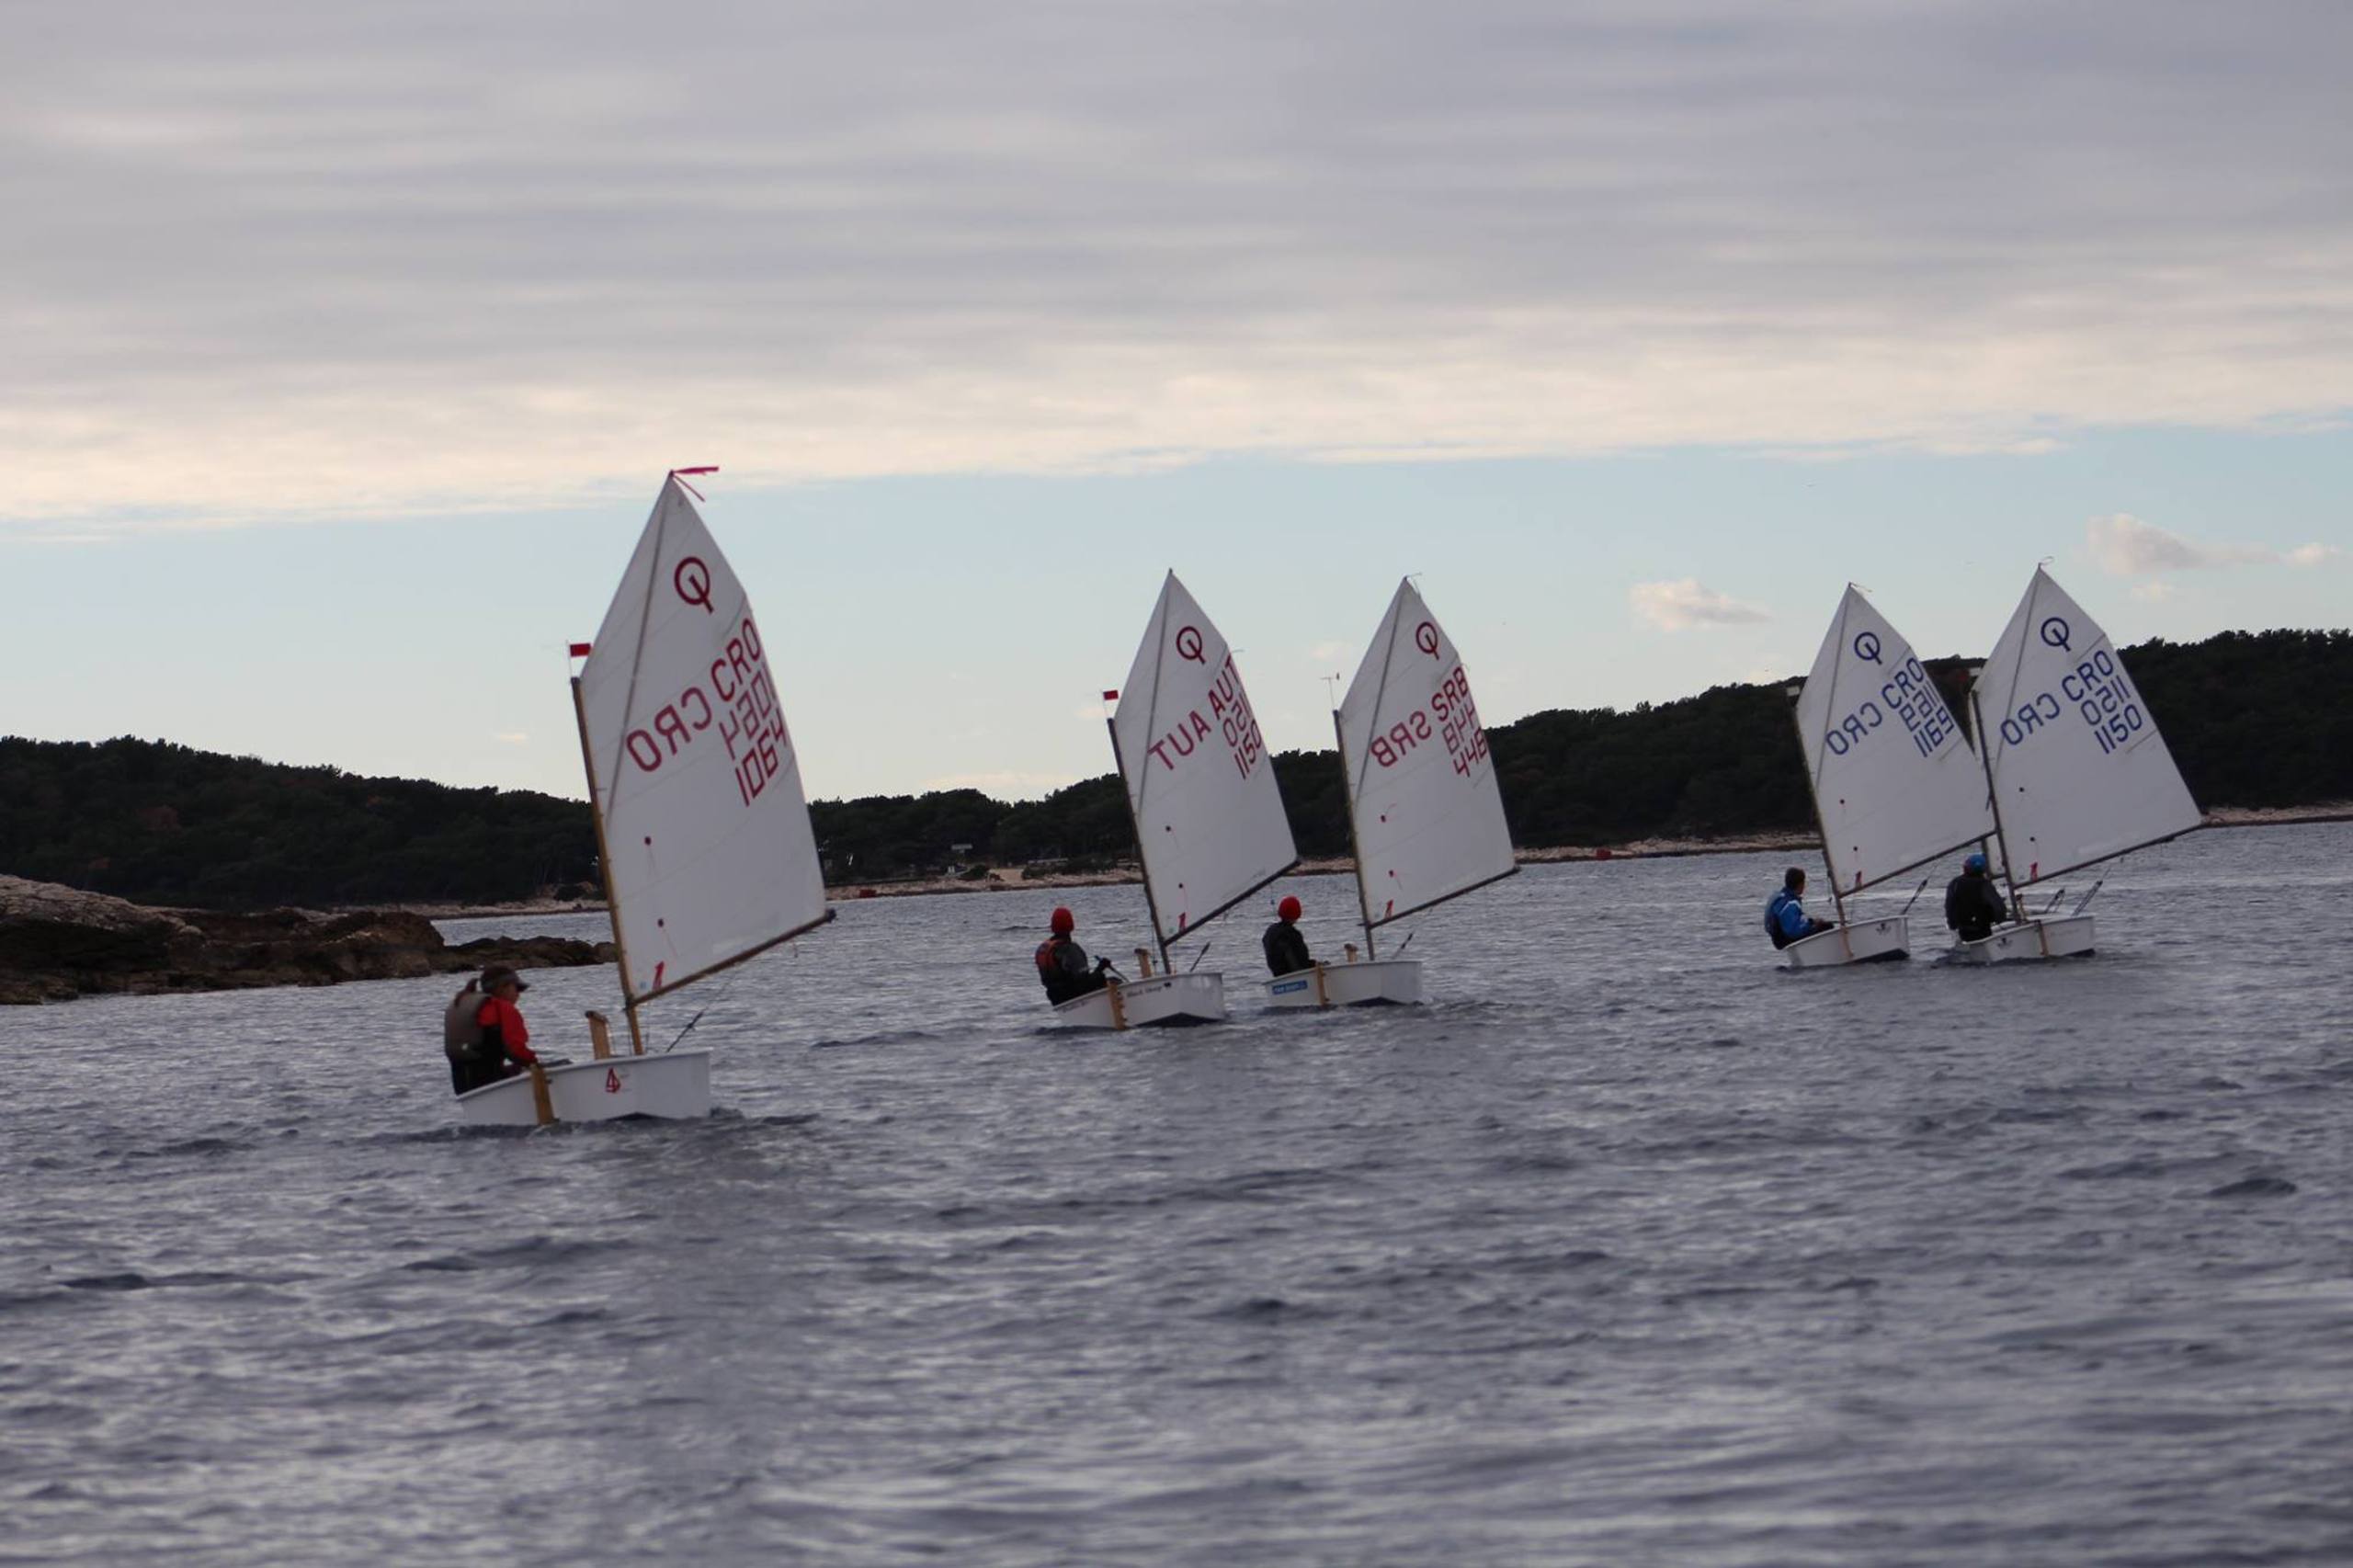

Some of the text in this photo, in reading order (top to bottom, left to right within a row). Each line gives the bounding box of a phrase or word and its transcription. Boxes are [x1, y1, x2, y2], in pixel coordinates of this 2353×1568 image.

[710, 618, 762, 701] CRO
[1208, 653, 1241, 721] AUT
[1881, 657, 1924, 710] CRO
[2062, 650, 2114, 702] CRO
[1431, 665, 1469, 722] SRB
[734, 707, 788, 807] 1064
[1234, 718, 1262, 780] 1150
[2094, 704, 2143, 755] 1150
